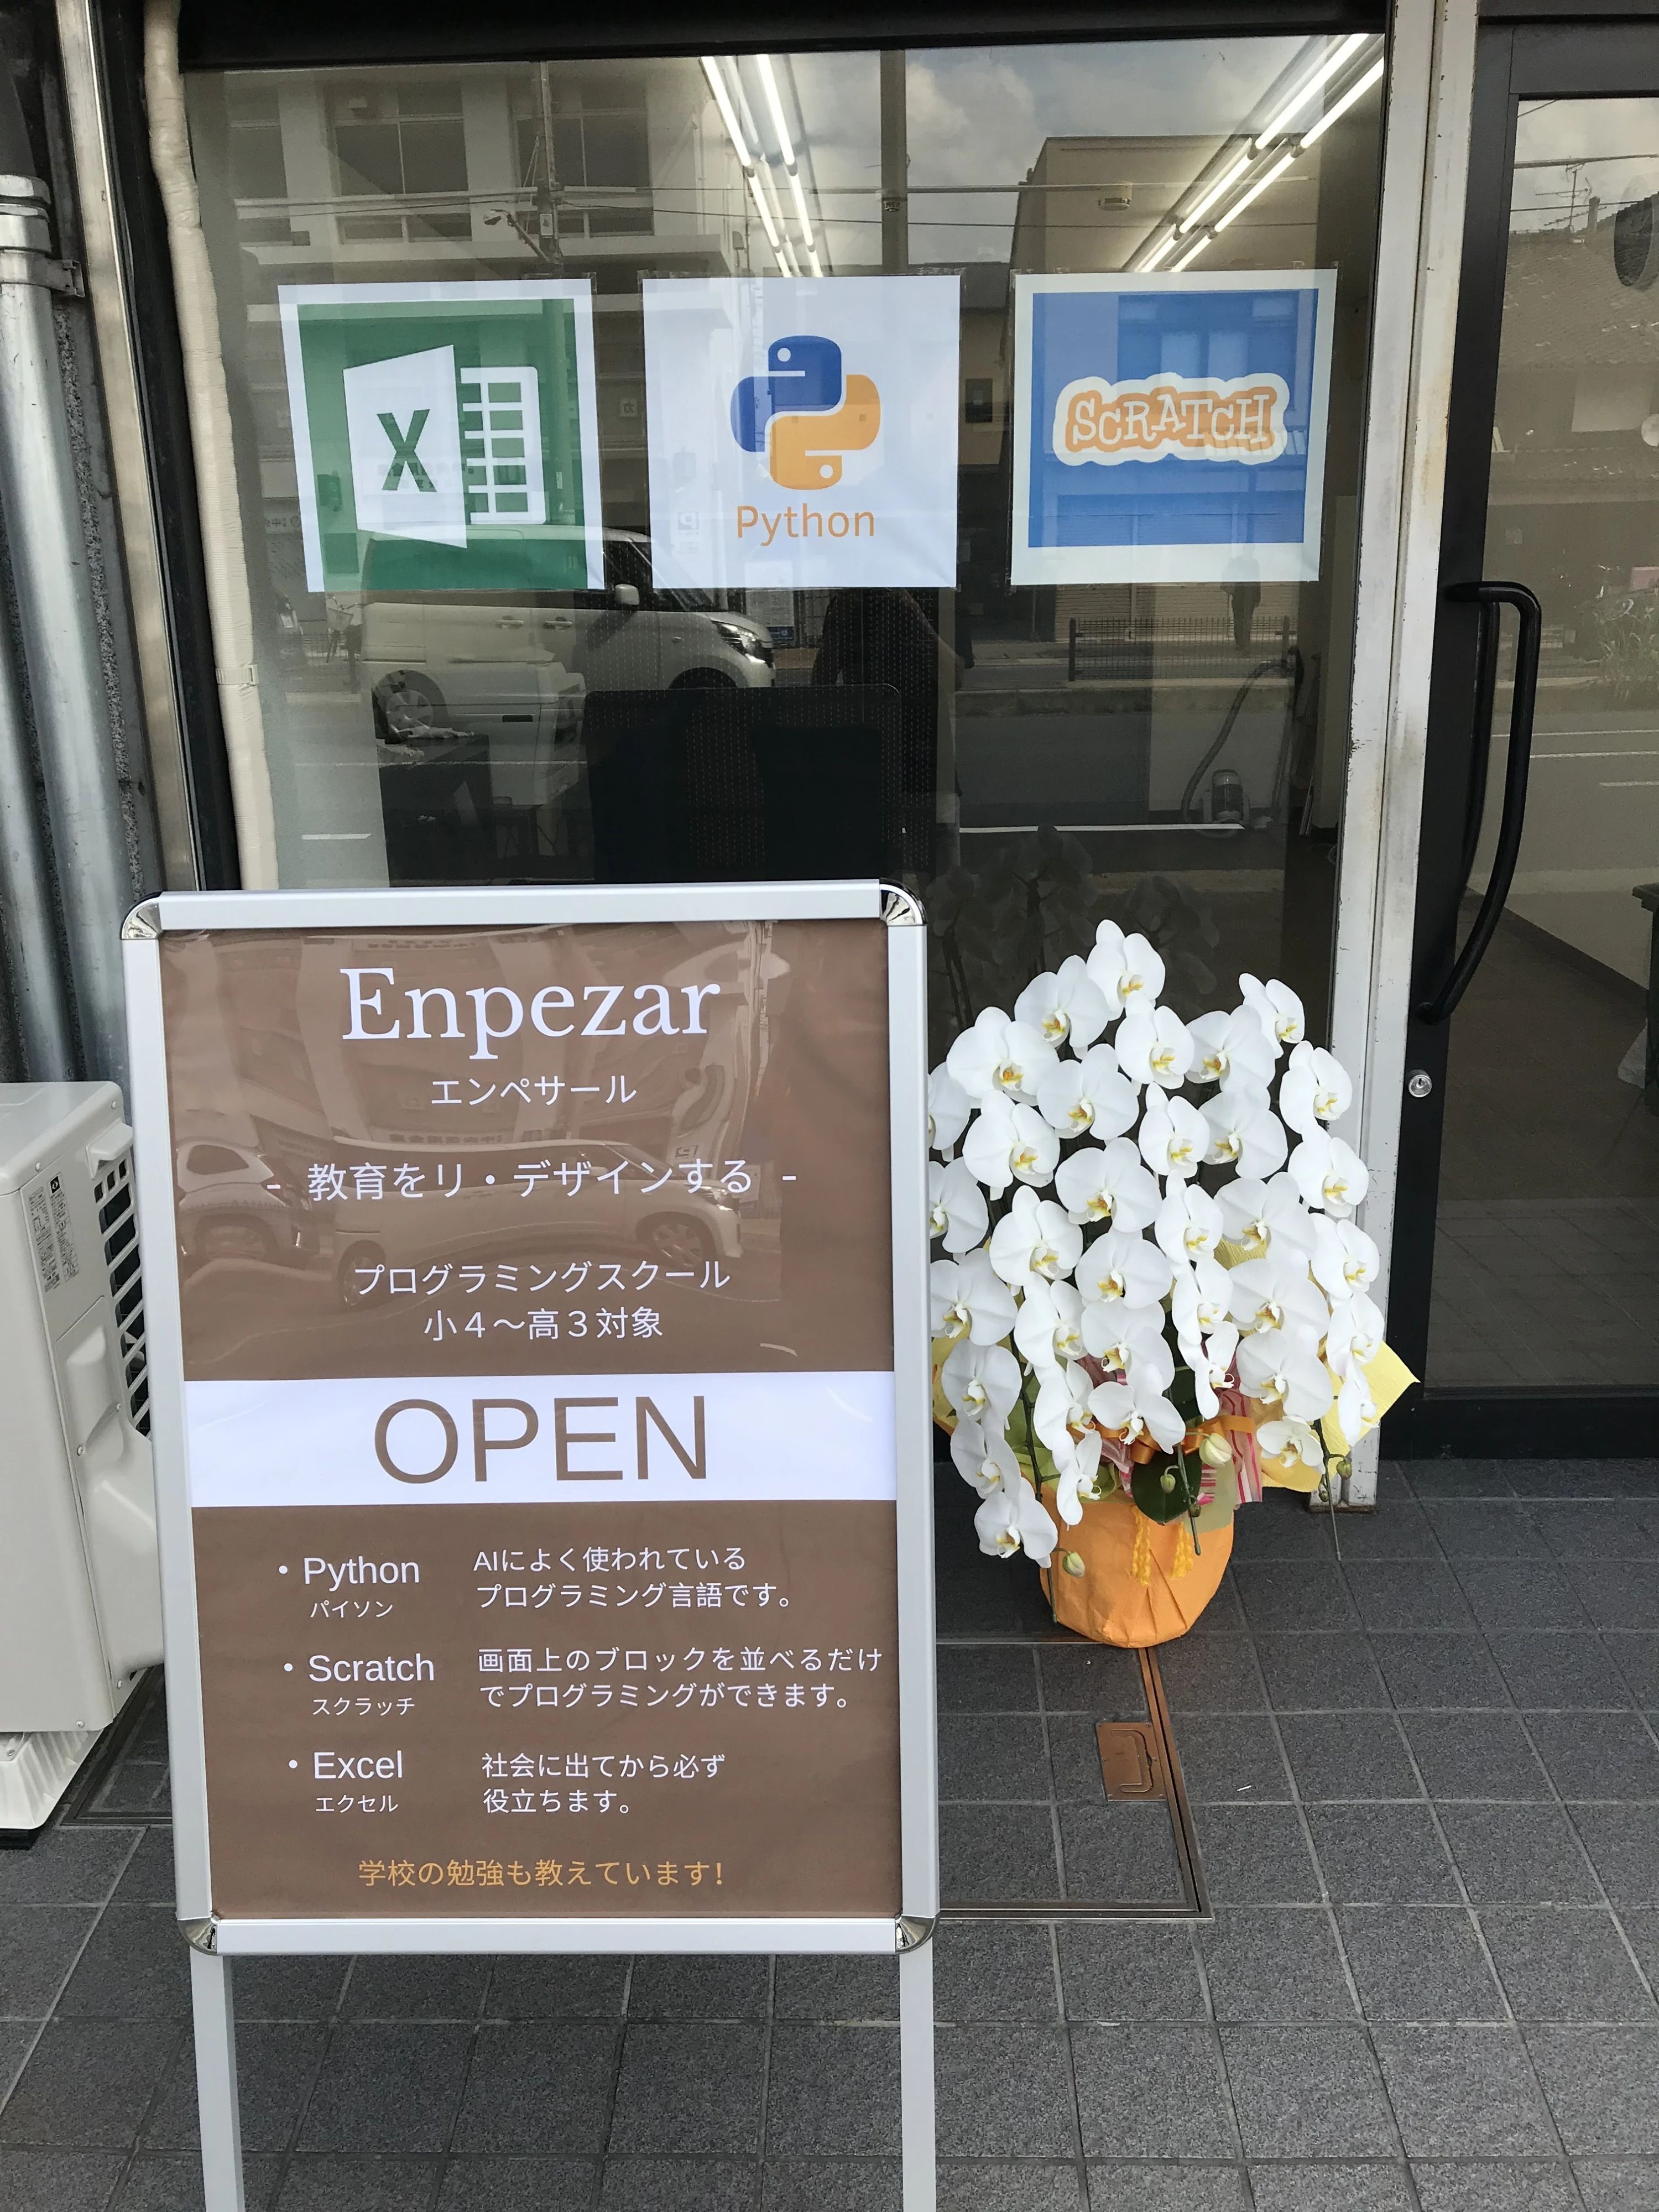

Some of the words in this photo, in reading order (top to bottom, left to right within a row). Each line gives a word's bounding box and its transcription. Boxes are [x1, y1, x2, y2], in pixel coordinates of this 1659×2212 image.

[1071, 392, 1271, 446] SCRATCH
[375, 407, 439, 494] X
[735, 502, 876, 547] Python
[339, 967, 721, 1060] Enpezar
[431, 1074, 638, 1106] エンペサール
[307, 1157, 752, 1202] 教育をリ・デザインする
[354, 1260, 731, 1296] プログラミングスクール
[374, 1395, 707, 1484] OPEN
[304, 1555, 420, 1592] Python
[472, 1546, 745, 1573] AIによく使われている
[310, 1599, 393, 1619] パイソン
[477, 1581, 789, 1609] プログラミング言語です。
[309, 1652, 435, 1683] Scratch
[478, 1646, 883, 1673] 画面上のブロックを並べるだけ
[312, 1697, 415, 1717] スクラッチ
[479, 1681, 847, 1708] でプログラミングができます。
[314, 1749, 403, 1780] Excel
[481, 1752, 726, 1779] 社会に出てから必ず
[315, 1794, 399, 1814] エクセル
[482, 1787, 629, 1814] 役立ちます。
[357, 1858, 725, 1887] 学校の勉強も教えています！
